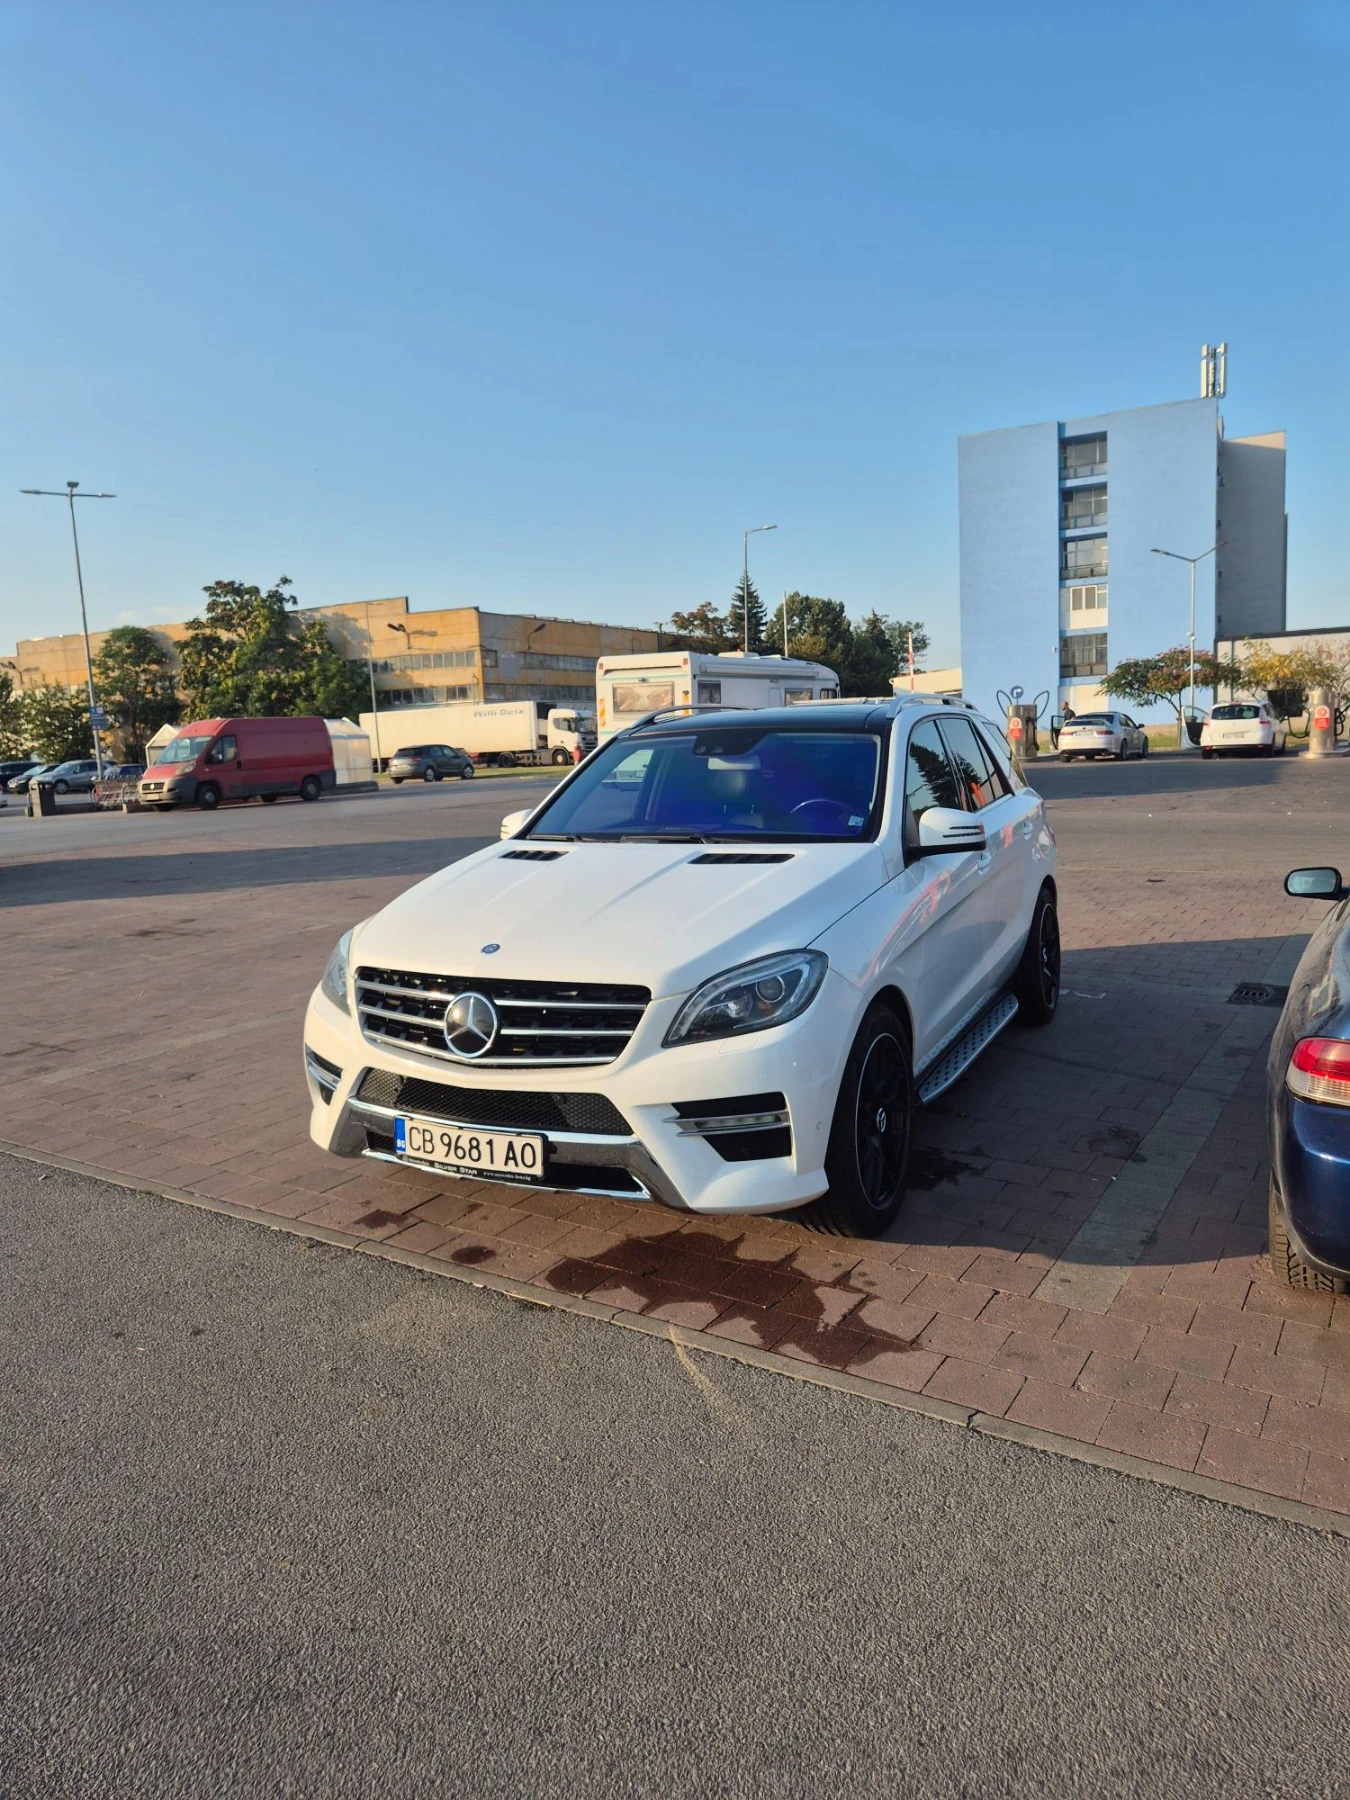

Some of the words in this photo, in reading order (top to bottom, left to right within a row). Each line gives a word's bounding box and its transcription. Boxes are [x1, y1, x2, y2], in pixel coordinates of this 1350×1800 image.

[396, 1139, 405, 1148] BG
[409, 1126, 434, 1155] CB
[440, 1132, 495, 1165] 9681
[504, 1140, 536, 1168] AO
[434, 1162, 458, 1171] SILVER
[459, 1166, 478, 1175] STAR
